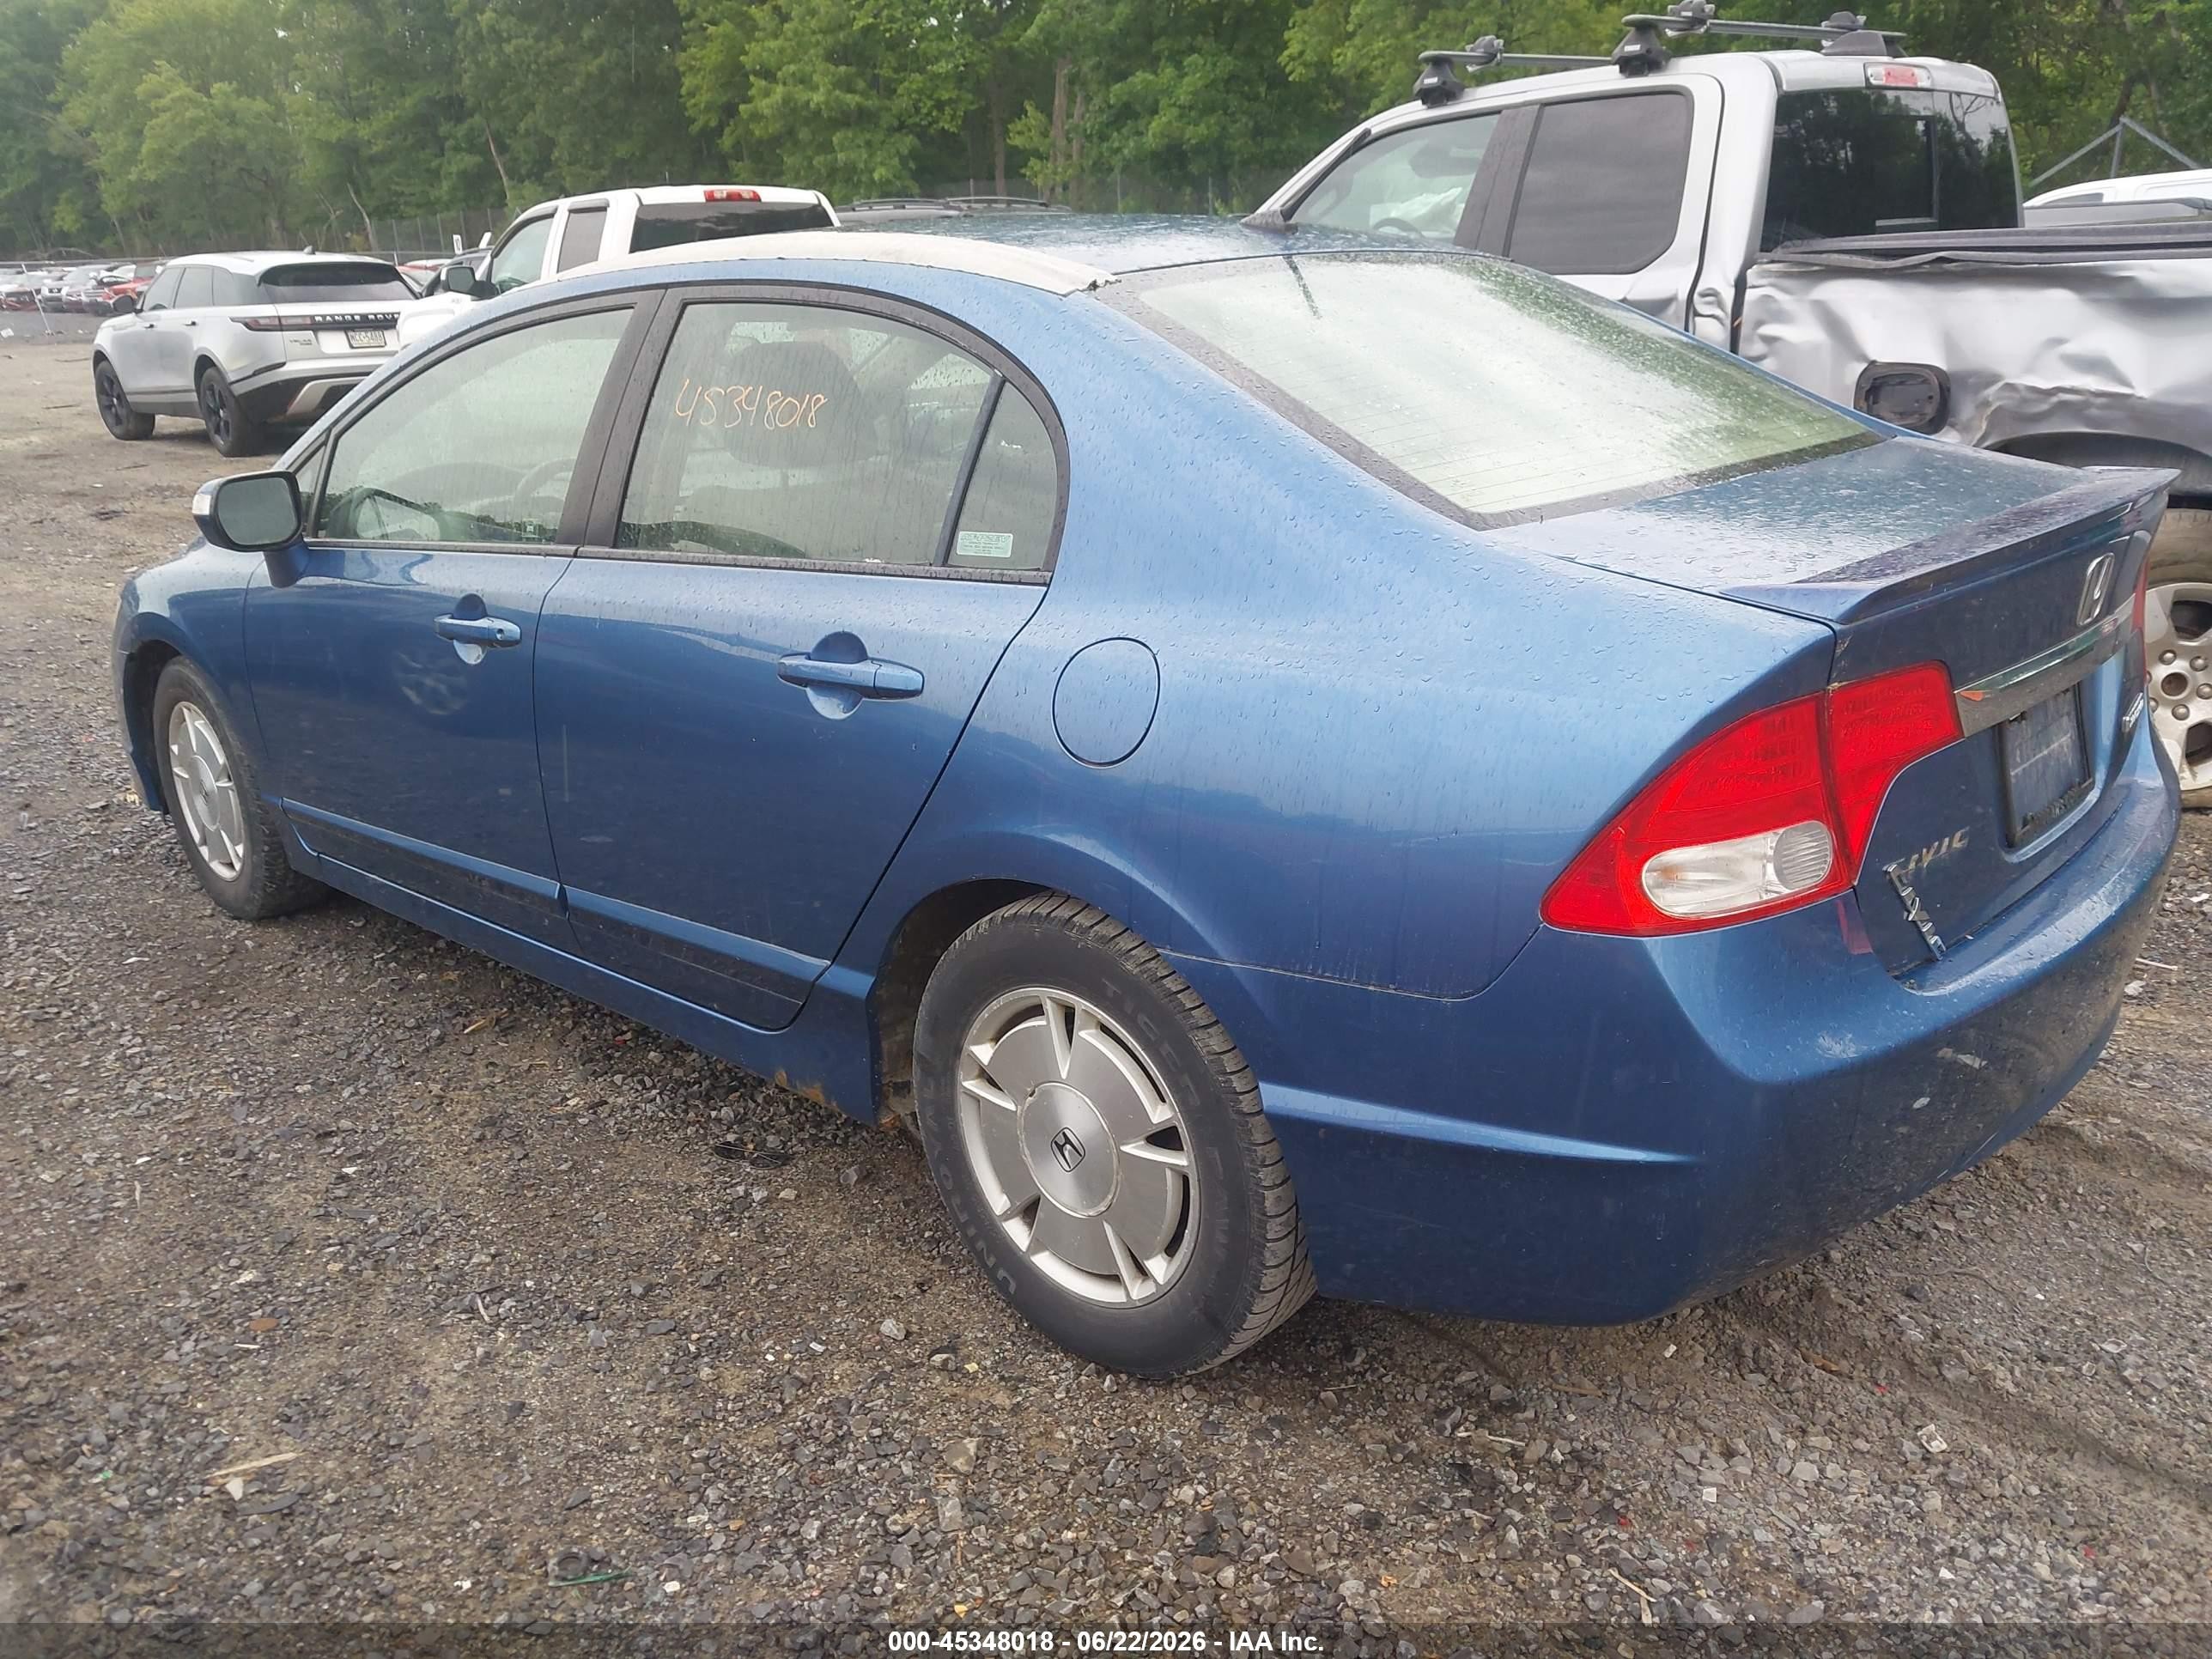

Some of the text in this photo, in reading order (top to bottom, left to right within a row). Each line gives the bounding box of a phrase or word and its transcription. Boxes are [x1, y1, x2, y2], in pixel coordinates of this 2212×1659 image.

[313, 313, 399, 323] RANGE ROVE
[676, 378, 828, 430] 45348018
